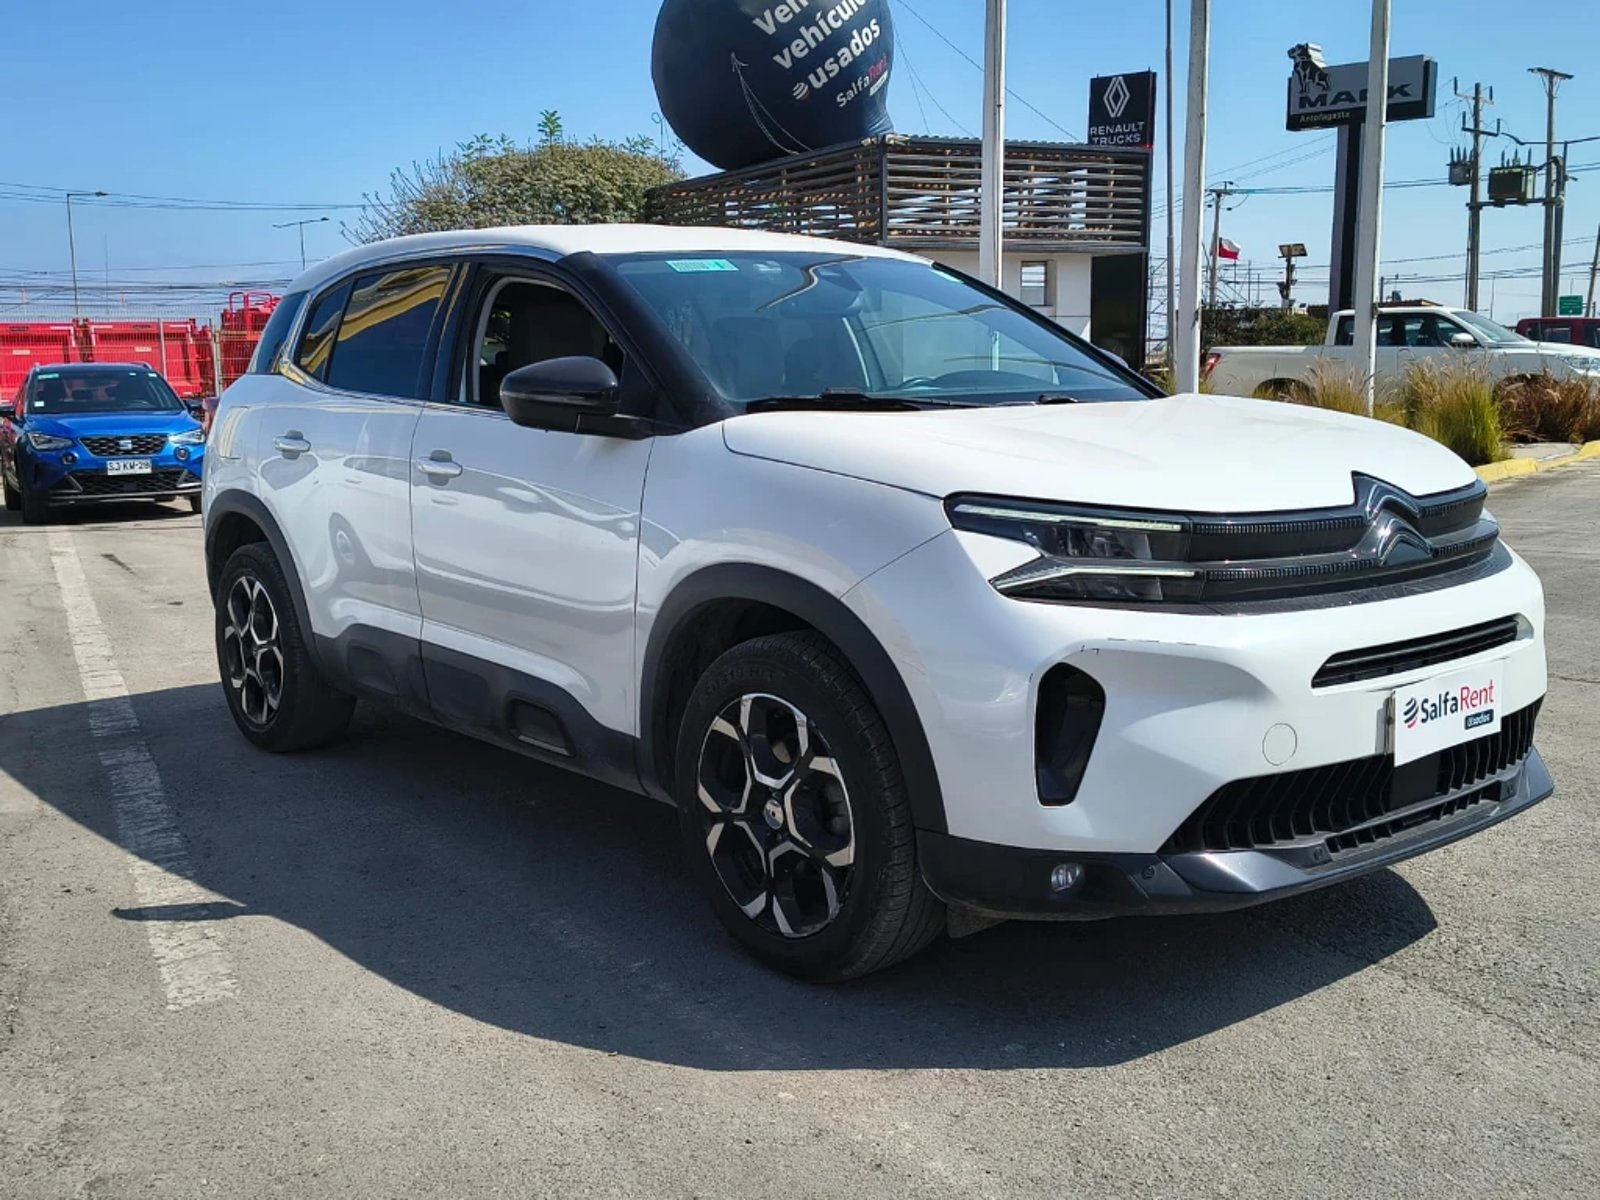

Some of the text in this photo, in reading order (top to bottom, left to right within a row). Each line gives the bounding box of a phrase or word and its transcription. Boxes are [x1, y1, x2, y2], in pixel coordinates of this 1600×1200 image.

[808, 18, 880, 88] usados
[1090, 121, 1145, 136] RENAULT
[1091, 132, 1141, 146] TRUCKS
[1421, 680, 1494, 723] SalfaRent
